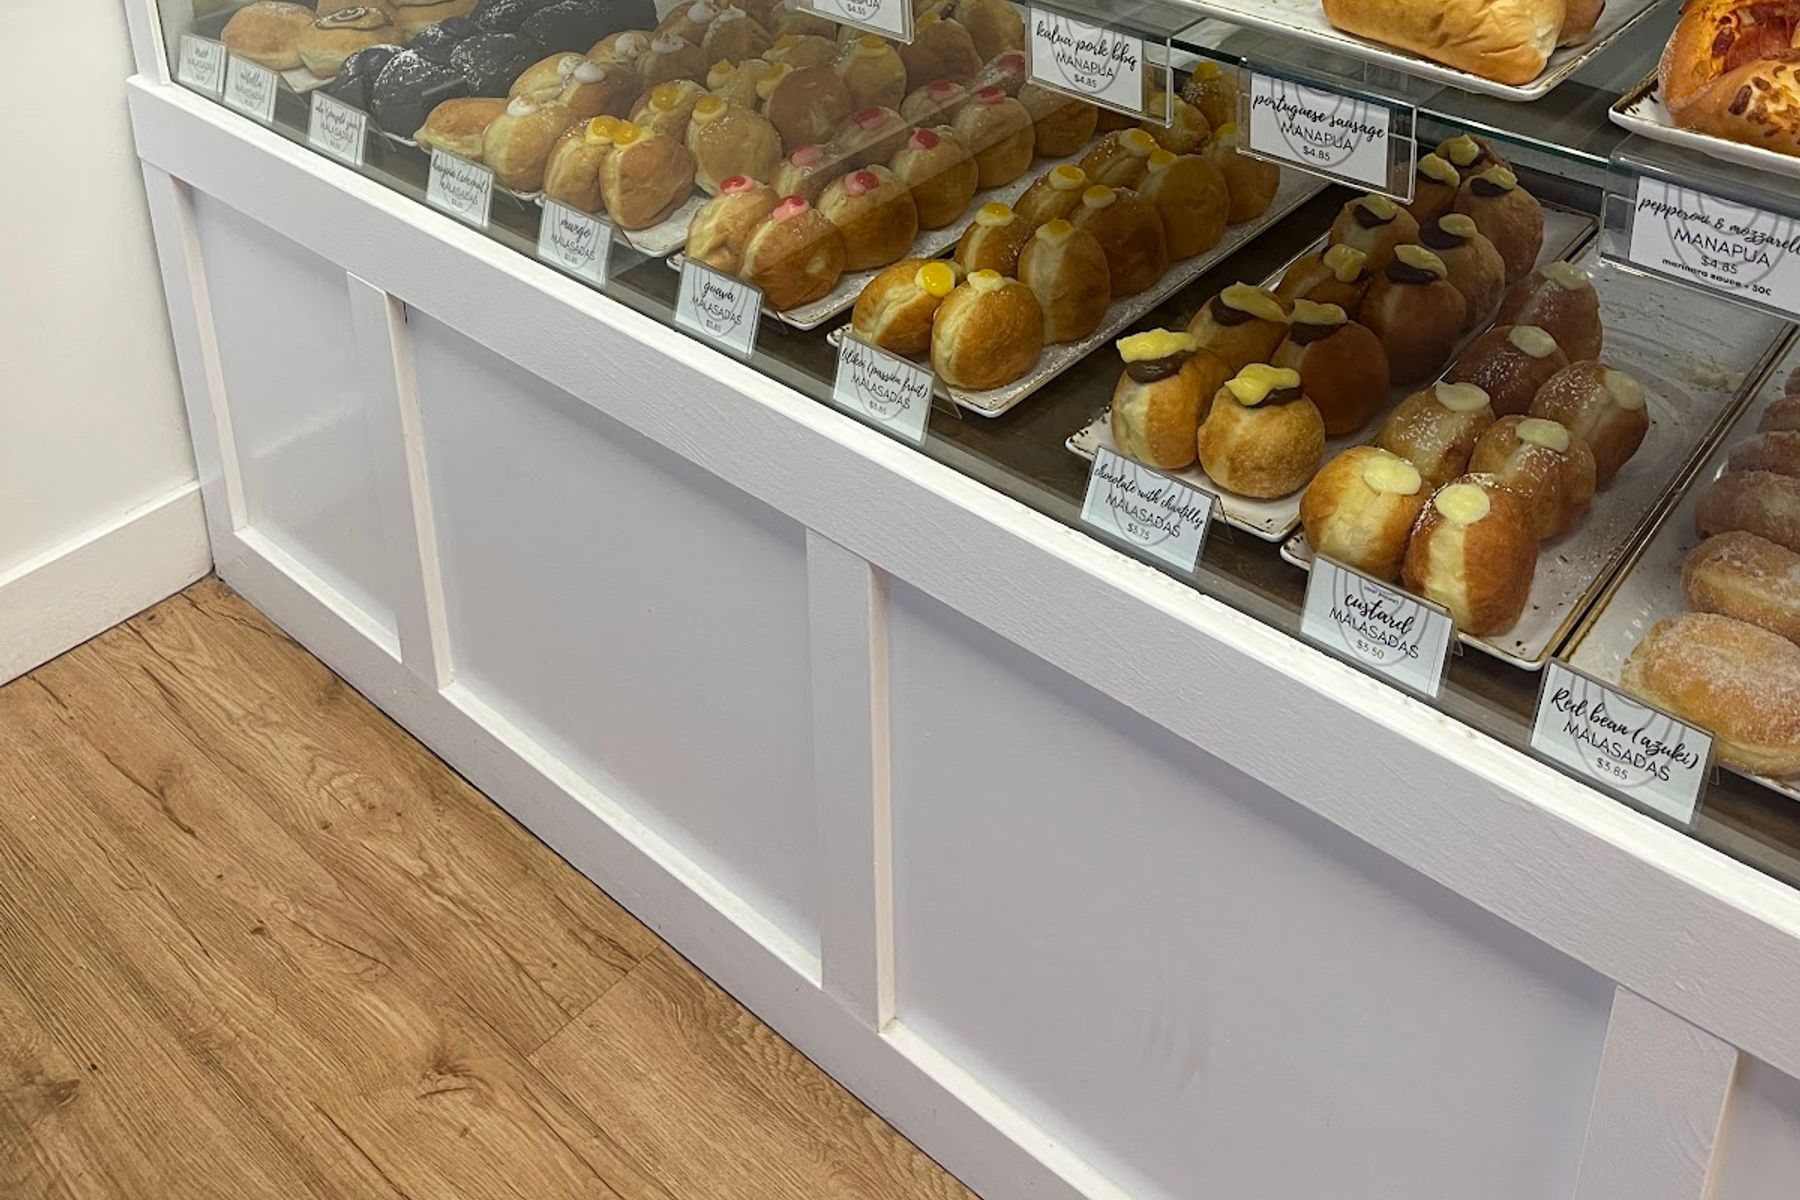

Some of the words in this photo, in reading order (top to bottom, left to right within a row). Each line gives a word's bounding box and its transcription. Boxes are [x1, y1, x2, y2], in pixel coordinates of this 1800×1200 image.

[1036, 20, 1074, 47] kalua
[1075, 39, 1109, 58] pork
[1111, 41, 1137, 72] bbq
[1056, 52, 1115, 78] MANAPUA
[1252, 93, 1327, 122] portuguese
[1328, 114, 1384, 143] sausage
[1280, 120, 1354, 153] MANAPUA
[1303, 145, 1331, 161] $4.85
[1638, 197, 1711, 225] pepperoni
[1714, 218, 1725, 229] &
[551, 234, 595, 261] MALASADAS
[561, 219, 591, 243] mango
[1674, 228, 1770, 267] MANAPUA
[1701, 255, 1738, 275] $4.85
[1710, 273, 1741, 288] sauce
[702, 282, 736, 302] guava
[690, 296, 742, 326] MALASADAS
[851, 375, 910, 409] MALASADAS
[867, 362, 901, 385] (passion
[901, 377, 928, 399] fruit)
[1094, 464, 1137, 493] chocolate
[1138, 489, 1162, 504] with
[1161, 495, 1203, 531] chantilly
[1106, 494, 1180, 538] MALASADAS
[1126, 522, 1150, 540] $3.75
[1344, 594, 1414, 635] custard
[1329, 607, 1419, 659] MALASADAS
[1356, 639, 1384, 660] $3.50
[1551, 687, 1588, 717] Red
[1590, 702, 1629, 735] bean
[1631, 727, 1699, 770] (azuki)
[1563, 721, 1671, 782] MALASADAS
